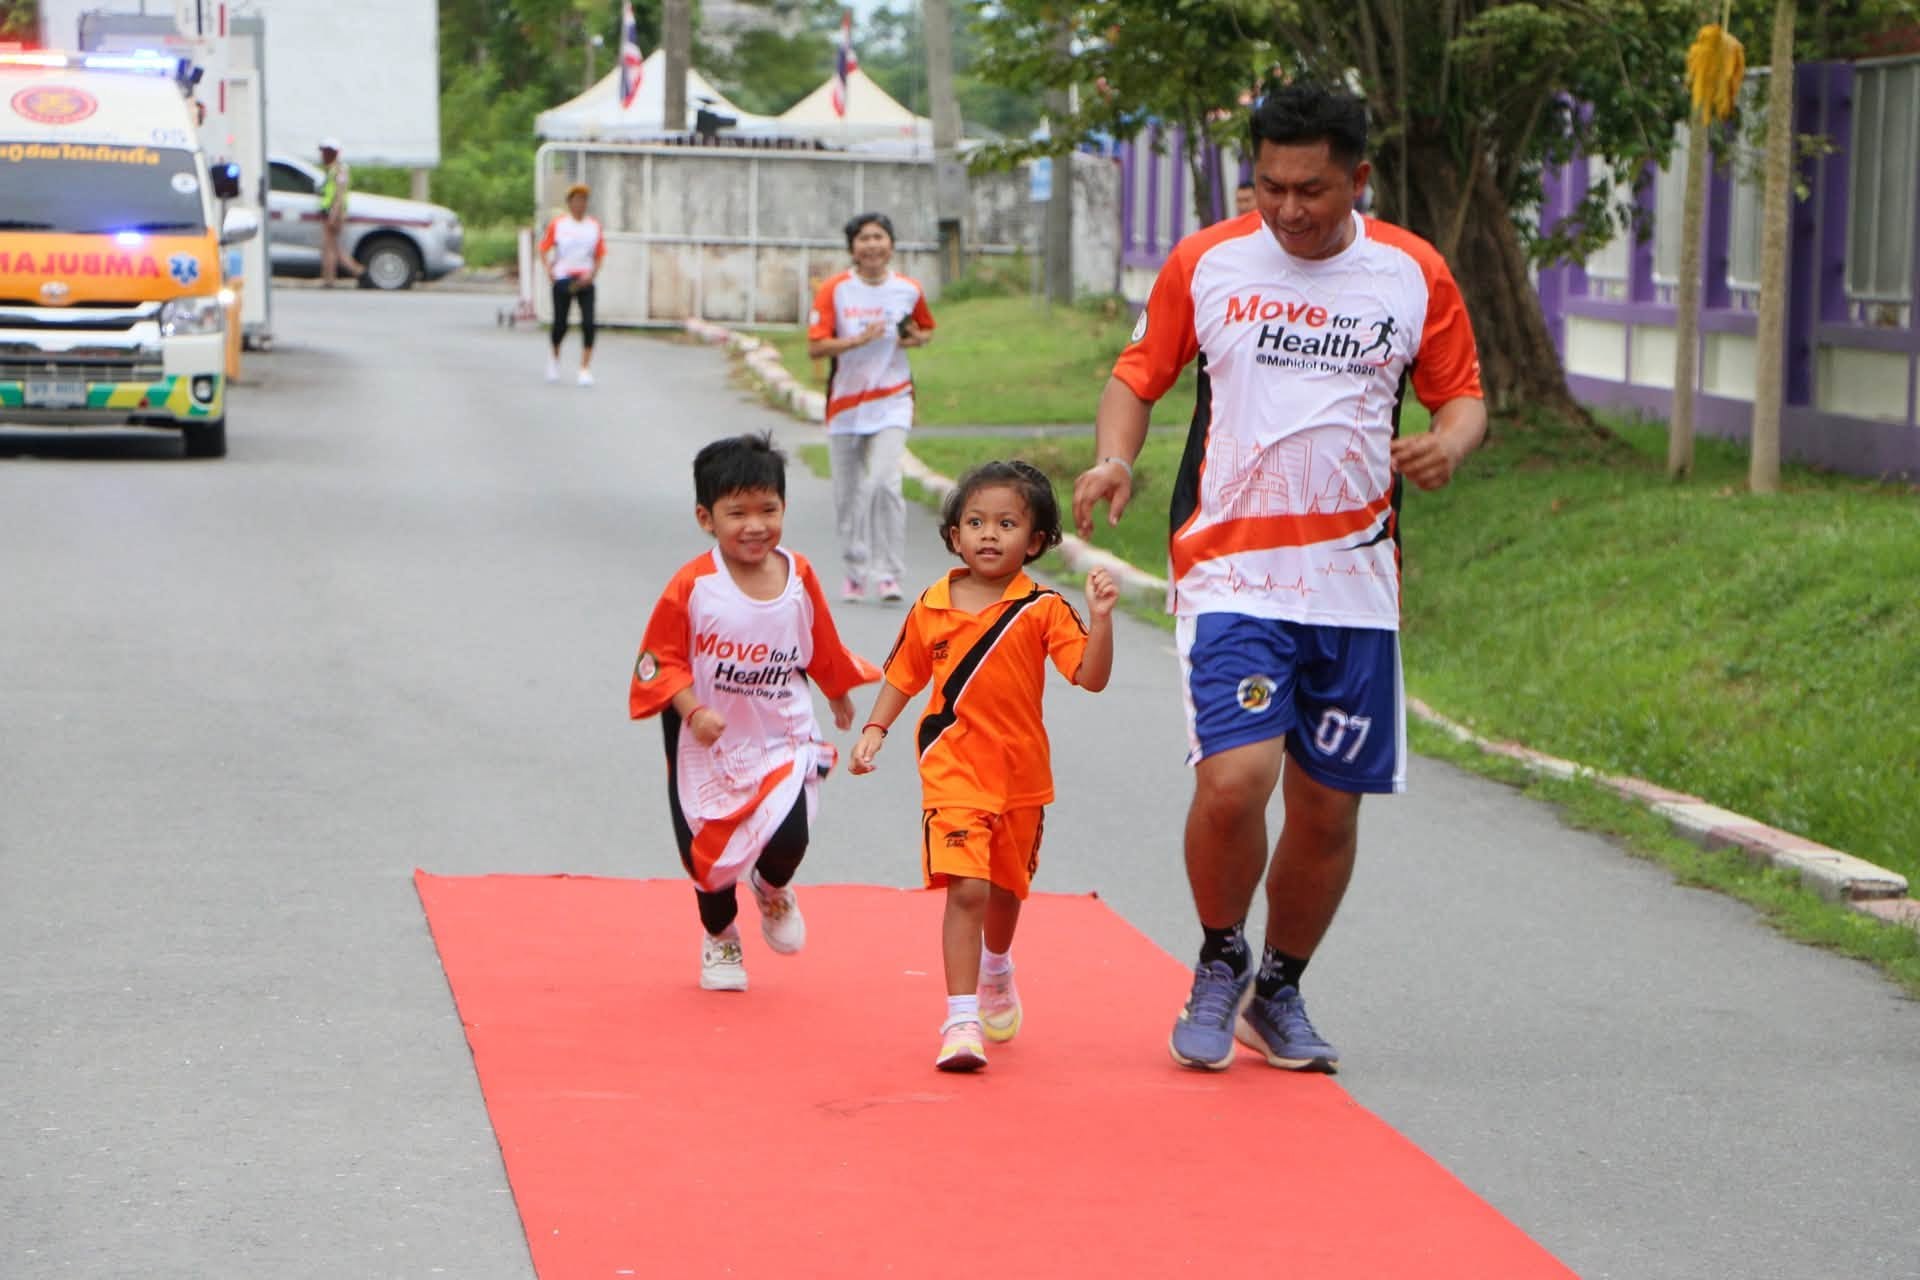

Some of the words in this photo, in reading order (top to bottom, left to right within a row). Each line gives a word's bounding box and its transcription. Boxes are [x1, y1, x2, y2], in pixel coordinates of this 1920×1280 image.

[1224, 295, 1328, 328] Move
[1332, 313, 1361, 329] for
[1257, 324, 1361, 358] Health
[1256, 354, 1317, 369] @Mahidol
[1320, 361, 1343, 375] Day
[694, 632, 768, 663] Move
[714, 661, 791, 687] Health
[756, 687, 776, 700] Day
[1315, 707, 1372, 763] 07
